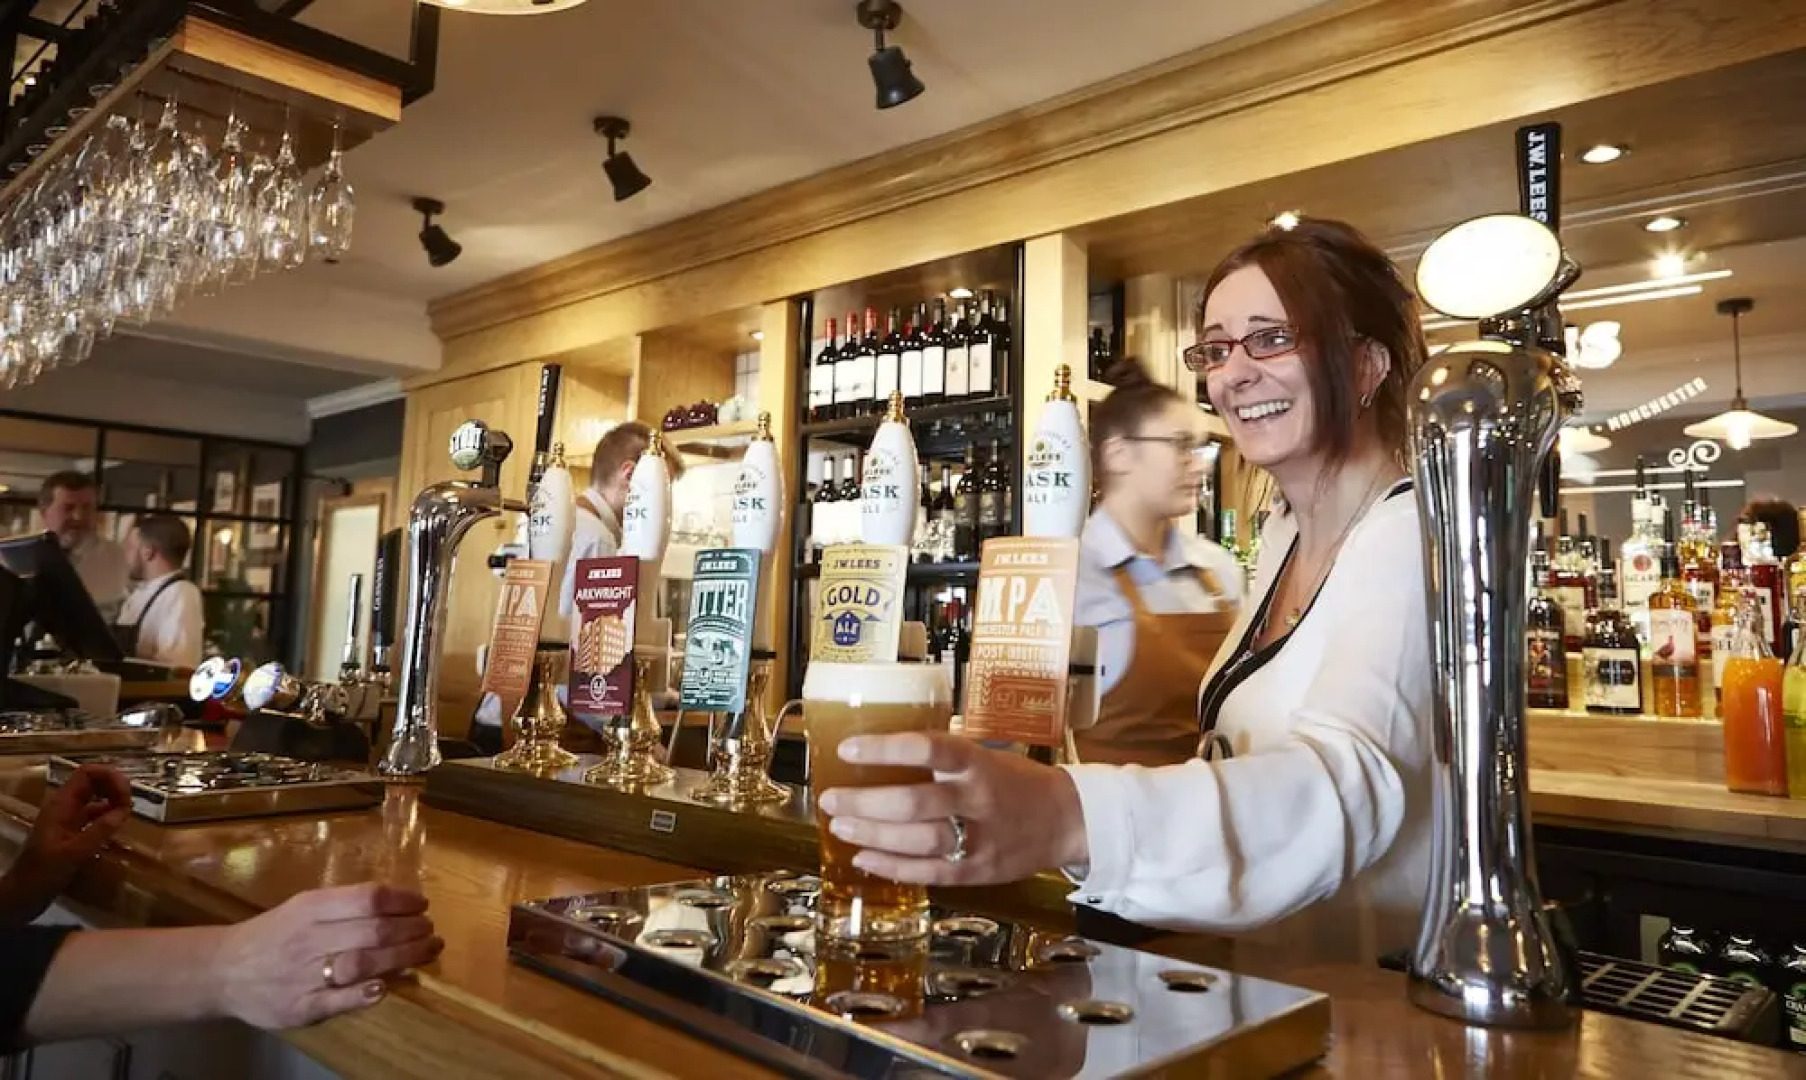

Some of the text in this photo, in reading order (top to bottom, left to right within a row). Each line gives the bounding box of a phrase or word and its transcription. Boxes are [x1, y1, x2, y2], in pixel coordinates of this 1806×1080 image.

[1607, 377, 1707, 431] MANCHESTER
[575, 585, 633, 600] ARKWRIGHT
[826, 585, 881, 607] GOLD
